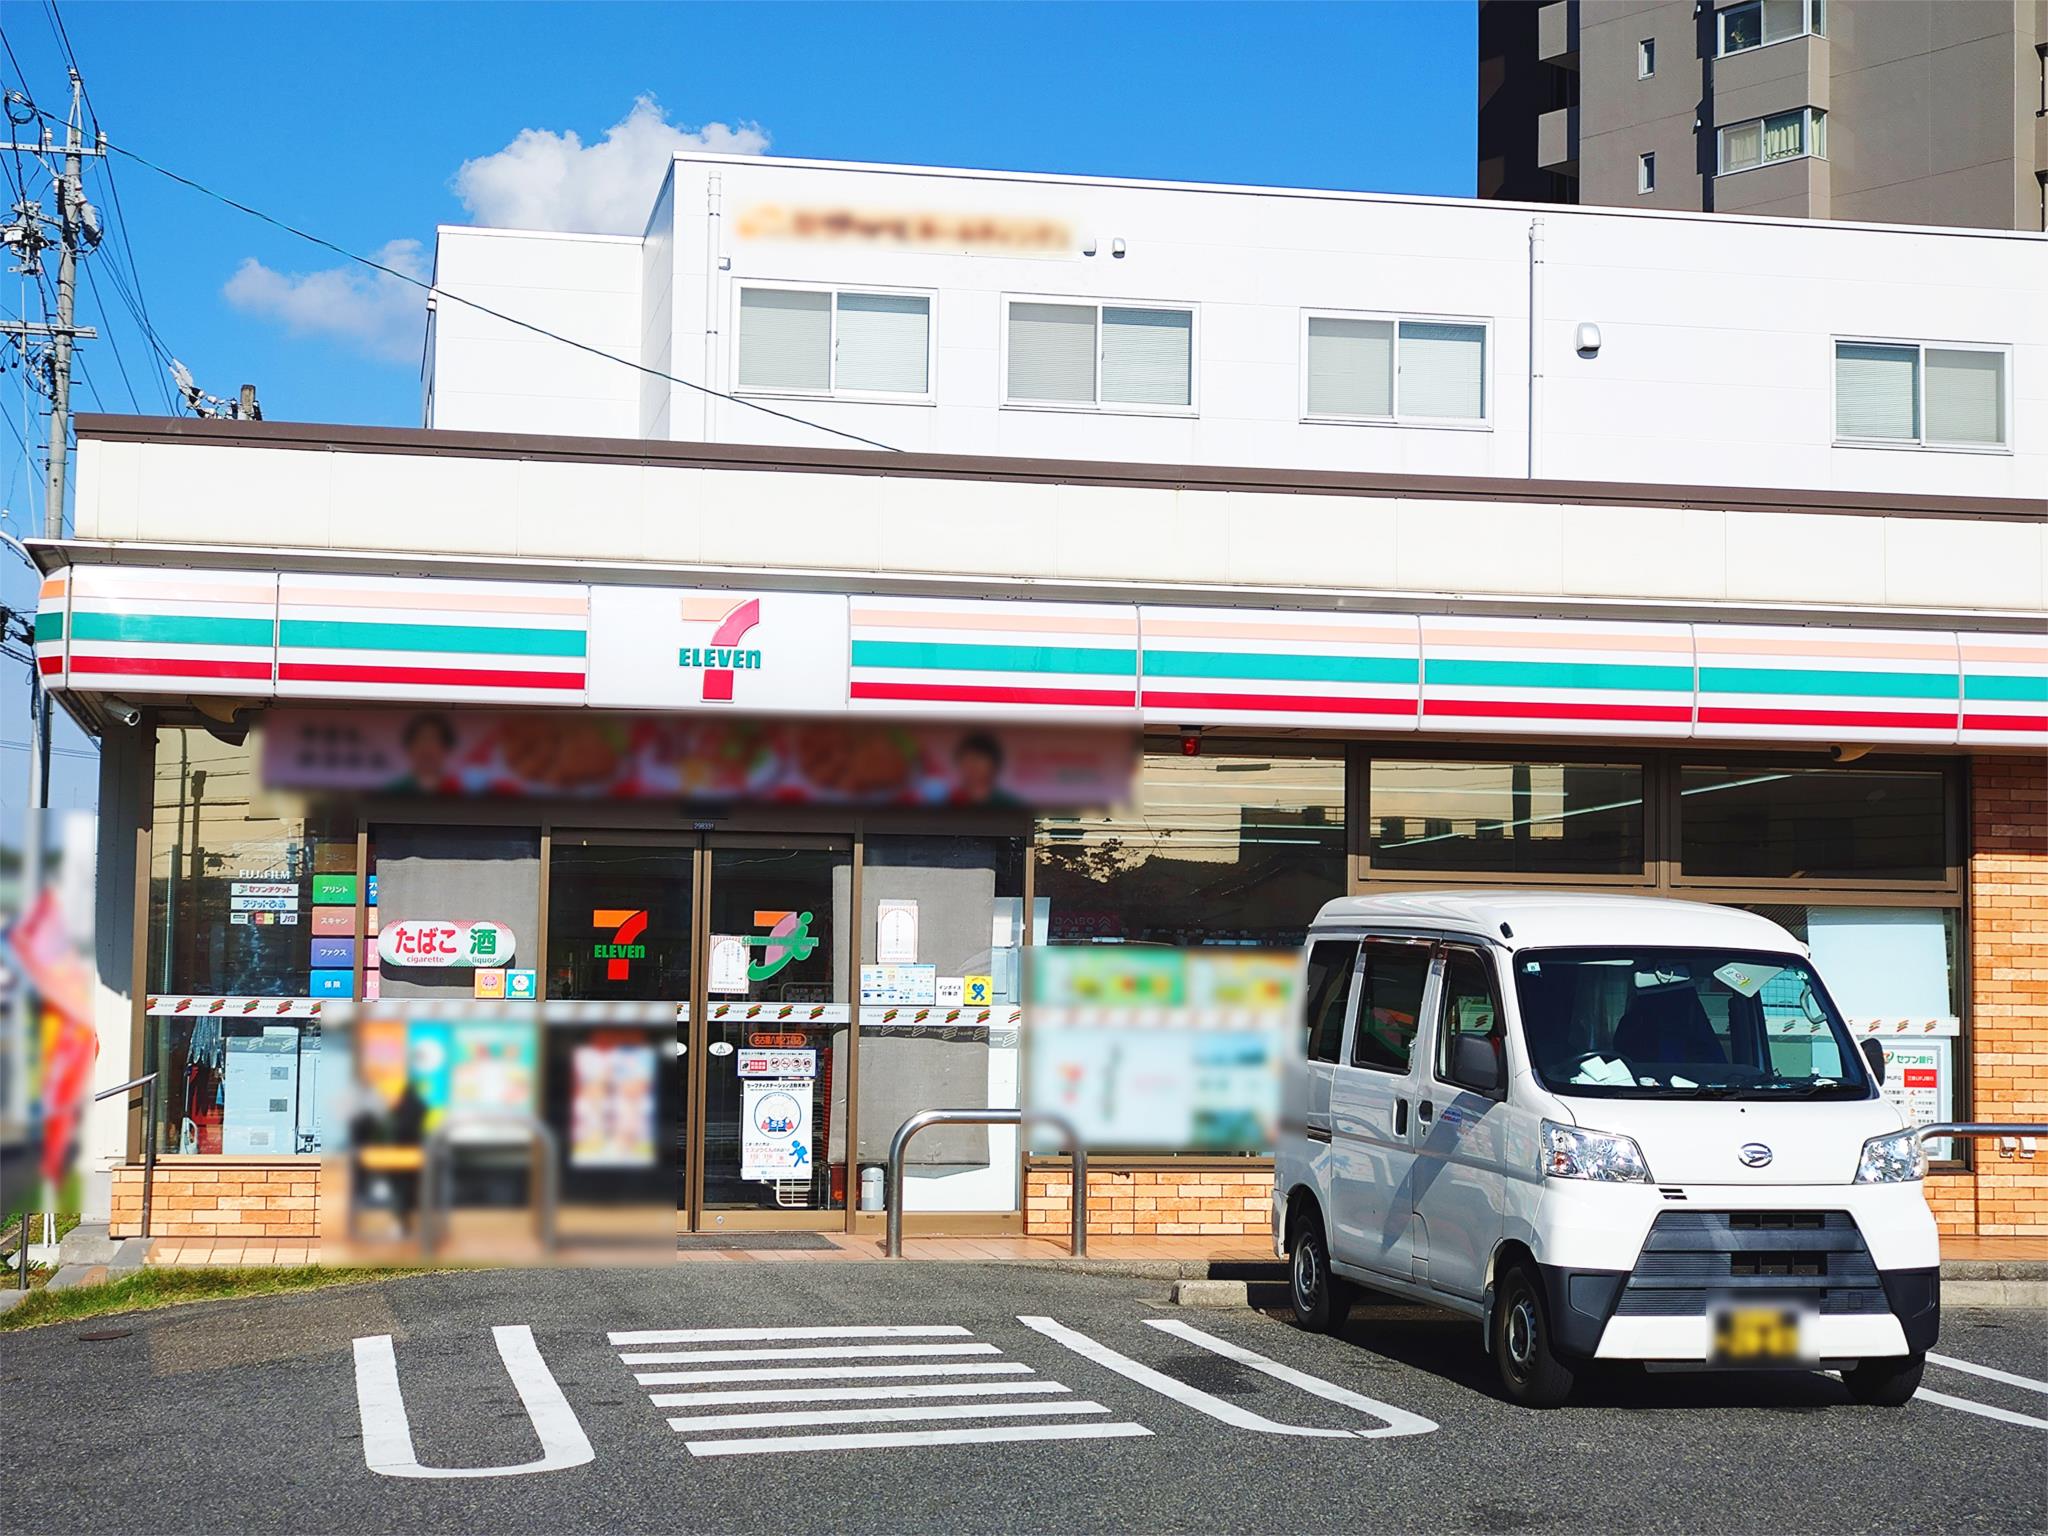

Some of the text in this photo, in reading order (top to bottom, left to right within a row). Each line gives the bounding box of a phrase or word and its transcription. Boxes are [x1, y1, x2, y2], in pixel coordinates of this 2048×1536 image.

[681, 597, 760, 701] 7
[322, 885, 349, 893] プリント
[320, 917, 348, 925] スキャン
[394, 926, 497, 955] たばこ 酒
[593, 909, 648, 980] 7
[320, 948, 347, 956] ファクス
[406, 956, 497, 964] cigarette liquor
[324, 980, 341, 989] 保険
[1897, 1056, 1934, 1064] セブン銀行
